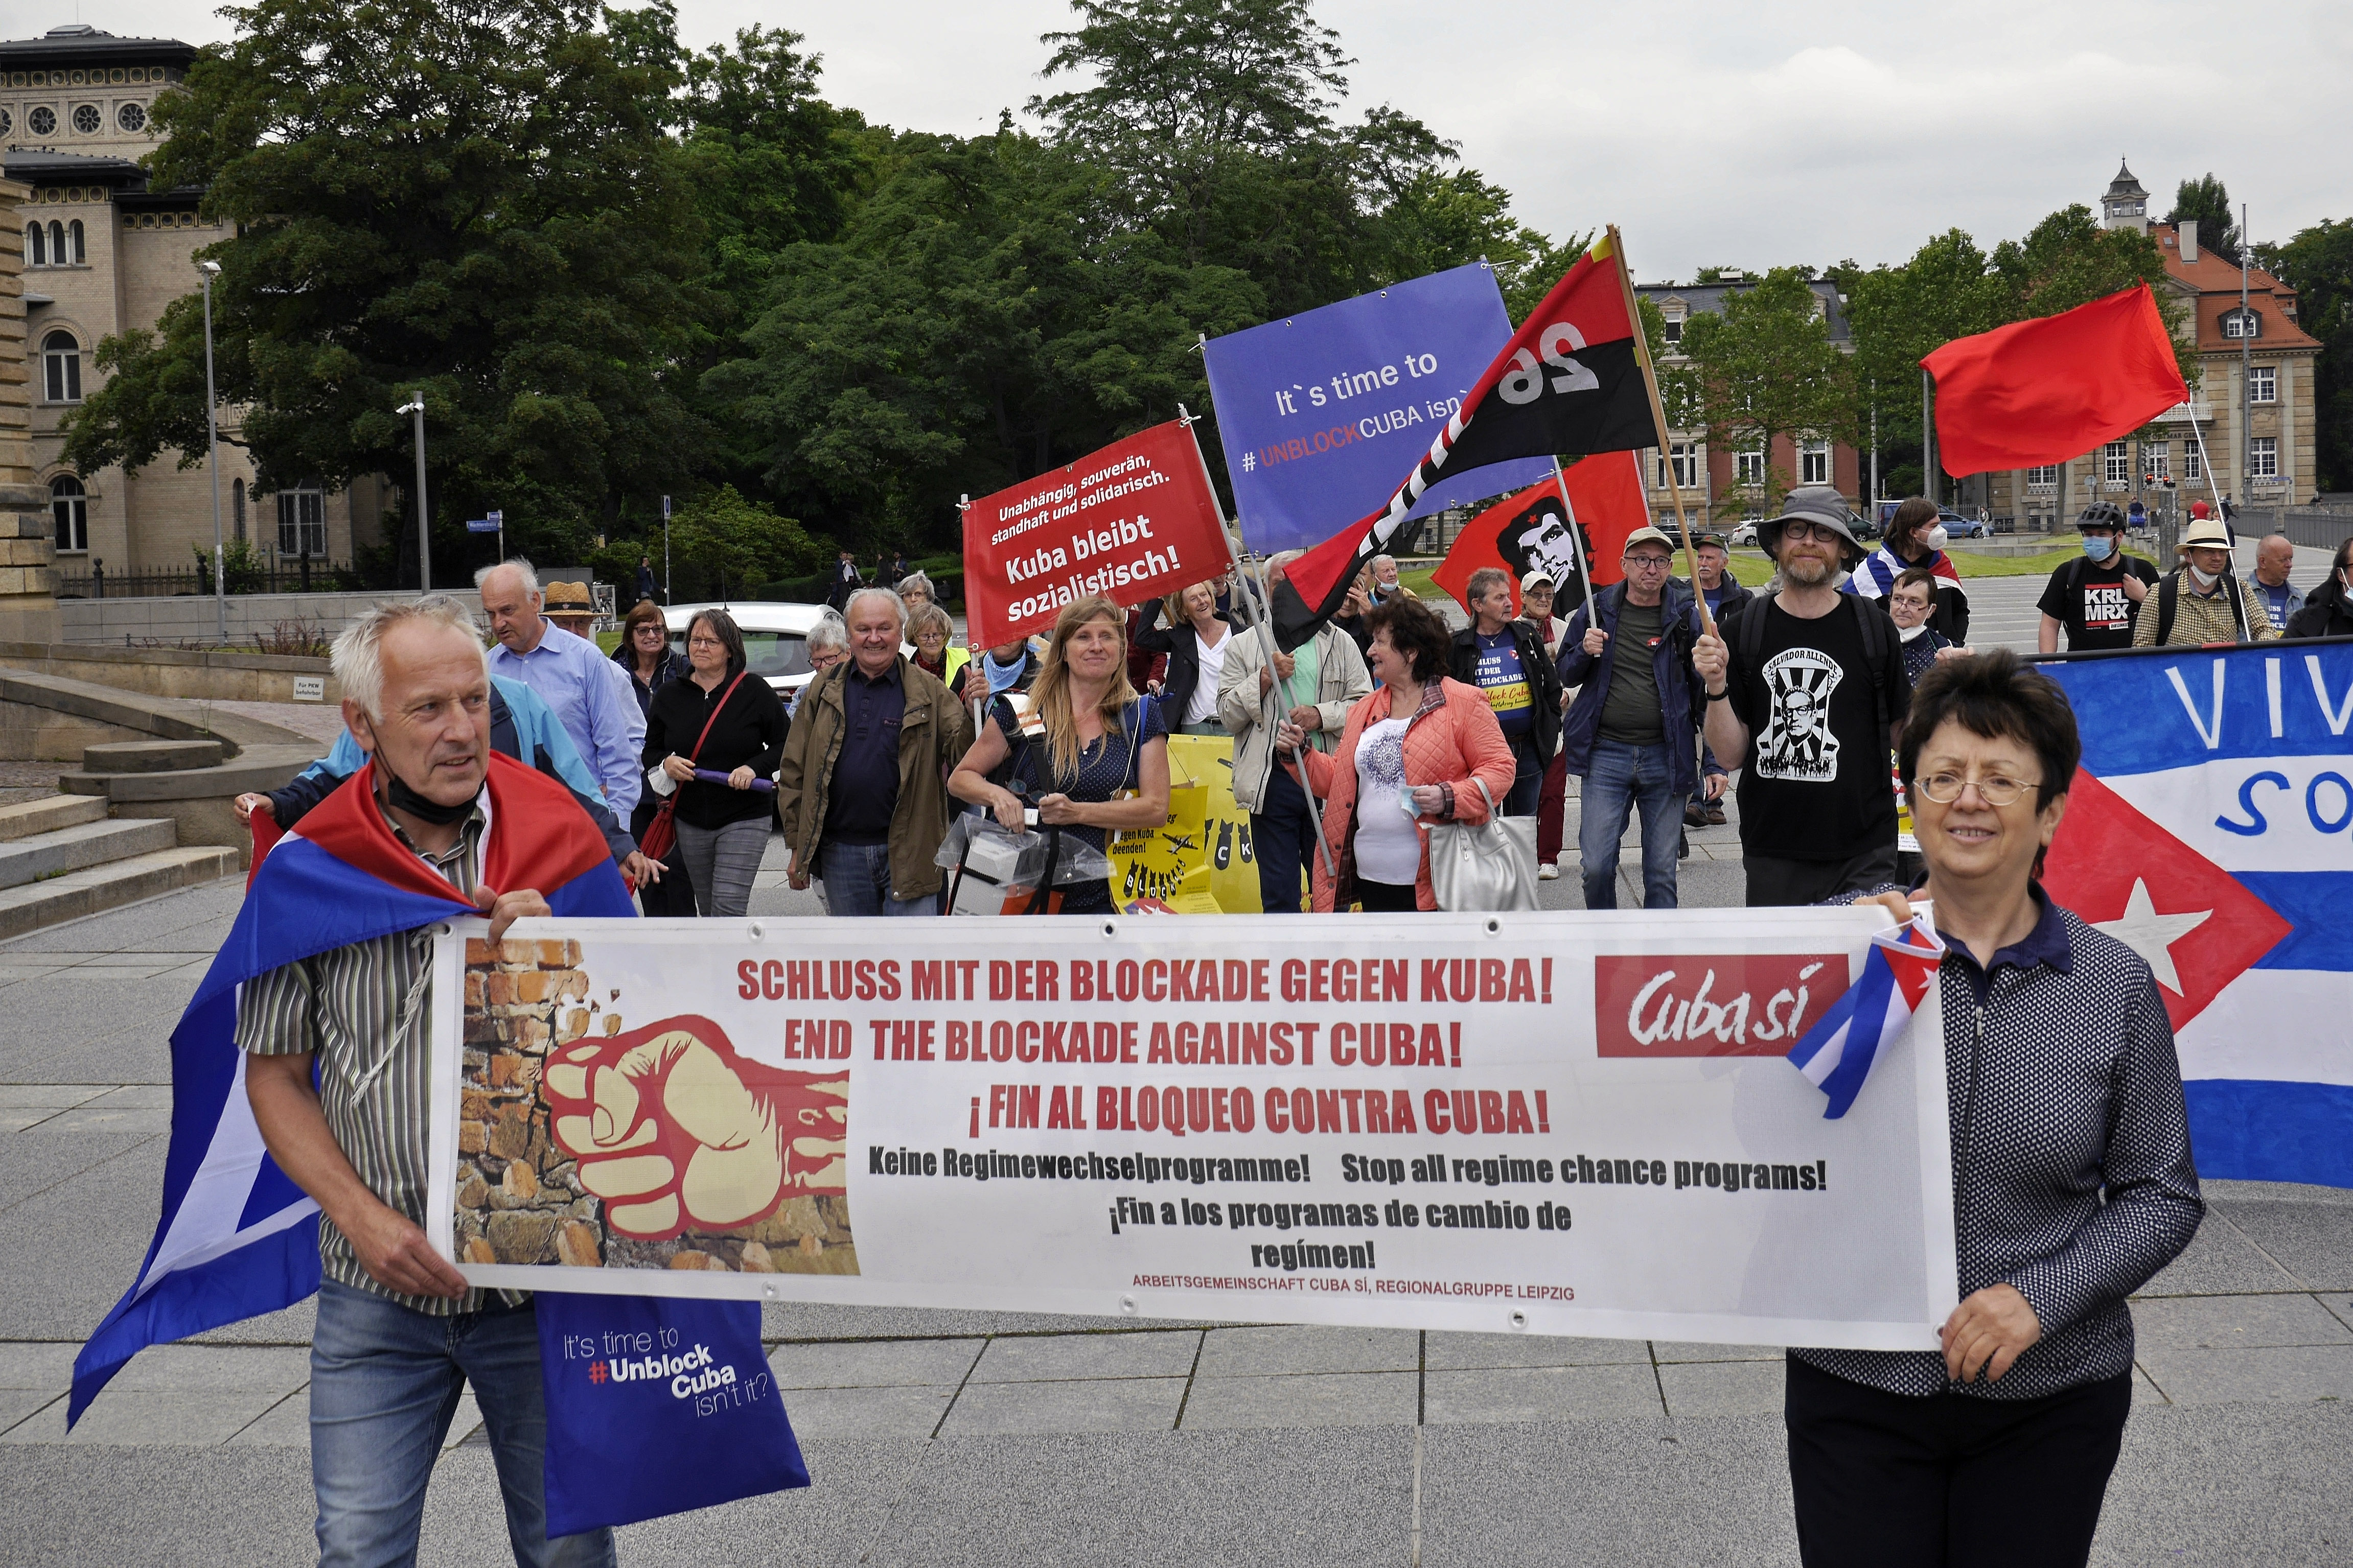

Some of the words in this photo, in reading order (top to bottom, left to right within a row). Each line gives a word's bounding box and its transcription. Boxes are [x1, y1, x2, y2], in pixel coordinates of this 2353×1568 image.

[1331, 364, 1399, 401] time
[1404, 352, 1438, 379] to
[1260, 406, 1423, 468] UNBLOCKCUBA
[991, 511, 1049, 546] standhaft
[1052, 502, 1078, 521] und
[1080, 469, 1170, 510] solidarisch.
[999, 480, 1078, 522] Unabhängig,
[1080, 454, 1151, 489] souverän,
[1005, 547, 1068, 584] Kuba
[1072, 514, 1154, 561] bleibt
[1007, 545, 1181, 622] sozialistisch!
[2085, 588, 2129, 604] KRL
[2085, 604, 2129, 621] MRX
[1474, 668, 1483, 676] IT
[1484, 666, 1502, 675] DER
[1475, 673, 1524, 686] S-BLOCKADE
[1768, 650, 1805, 672] SALVADOR
[1806, 650, 1838, 675] ALLENDE
[2164, 655, 2353, 750] VIV
[2214, 770, 2353, 836] SO
[1120, 830, 1136, 842] egen
[737, 958, 901, 1001] SCHLUSS
[911, 959, 979, 1001] MIT
[988, 960, 1059, 1001] DER
[1070, 958, 1270, 1002] BLOCKADE
[1280, 958, 1409, 1002] GEGEN
[1420, 957, 1553, 1004] KUBA!
[784, 1019, 852, 1060] END
[870, 1020, 935, 1061] THE
[945, 1021, 1138, 1064] BLOCKADE
[1147, 1021, 1320, 1066] AGAINST
[1330, 1022, 1462, 1068] CUBA!
[1048, 1085, 1087, 1130] AL
[1096, 1086, 1255, 1137] BLOQUEO
[1264, 1087, 1418, 1135] CONTRA
[1424, 1088, 1551, 1135] CUBA!
[868, 1145, 937, 1176] Keine
[943, 1147, 1311, 1184] Regimewechselprogramme!
[1341, 1153, 1405, 1185] Stop
[1411, 1154, 1447, 1183] all
[1451, 1154, 1554, 1188] regime
[1560, 1155, 1667, 1186] chance
[1674, 1159, 1828, 1192] programs!
[1109, 1196, 1155, 1235] ¡Fin
[1160, 1203, 1176, 1226] a
[1182, 1198, 1222, 1226] los
[1229, 1201, 1379, 1230] programas
[1385, 1199, 1419, 1227] de
[1425, 1200, 1530, 1230] cambio
[1536, 1200, 1572, 1231] de
[1251, 1238, 1376, 1271] regímen!
[1133, 1274, 1305, 1291] ARBEITSGEMEINSCHAFT
[1309, 1278, 1350, 1292] CUBA
[1354, 1276, 1372, 1295] SÍ,
[1376, 1279, 1514, 1299] REGIONALGRUPPE
[1517, 1284, 1575, 1302] LEIPZIG
[564, 1333, 595, 1360] It's
[603, 1330, 652, 1355] time
[658, 1325, 678, 1350] to
[589, 1343, 713, 1385] #Unblock
[671, 1364, 737, 1399] Cuba
[695, 1383, 742, 1418] isn't
[744, 1371, 768, 1403] it?
